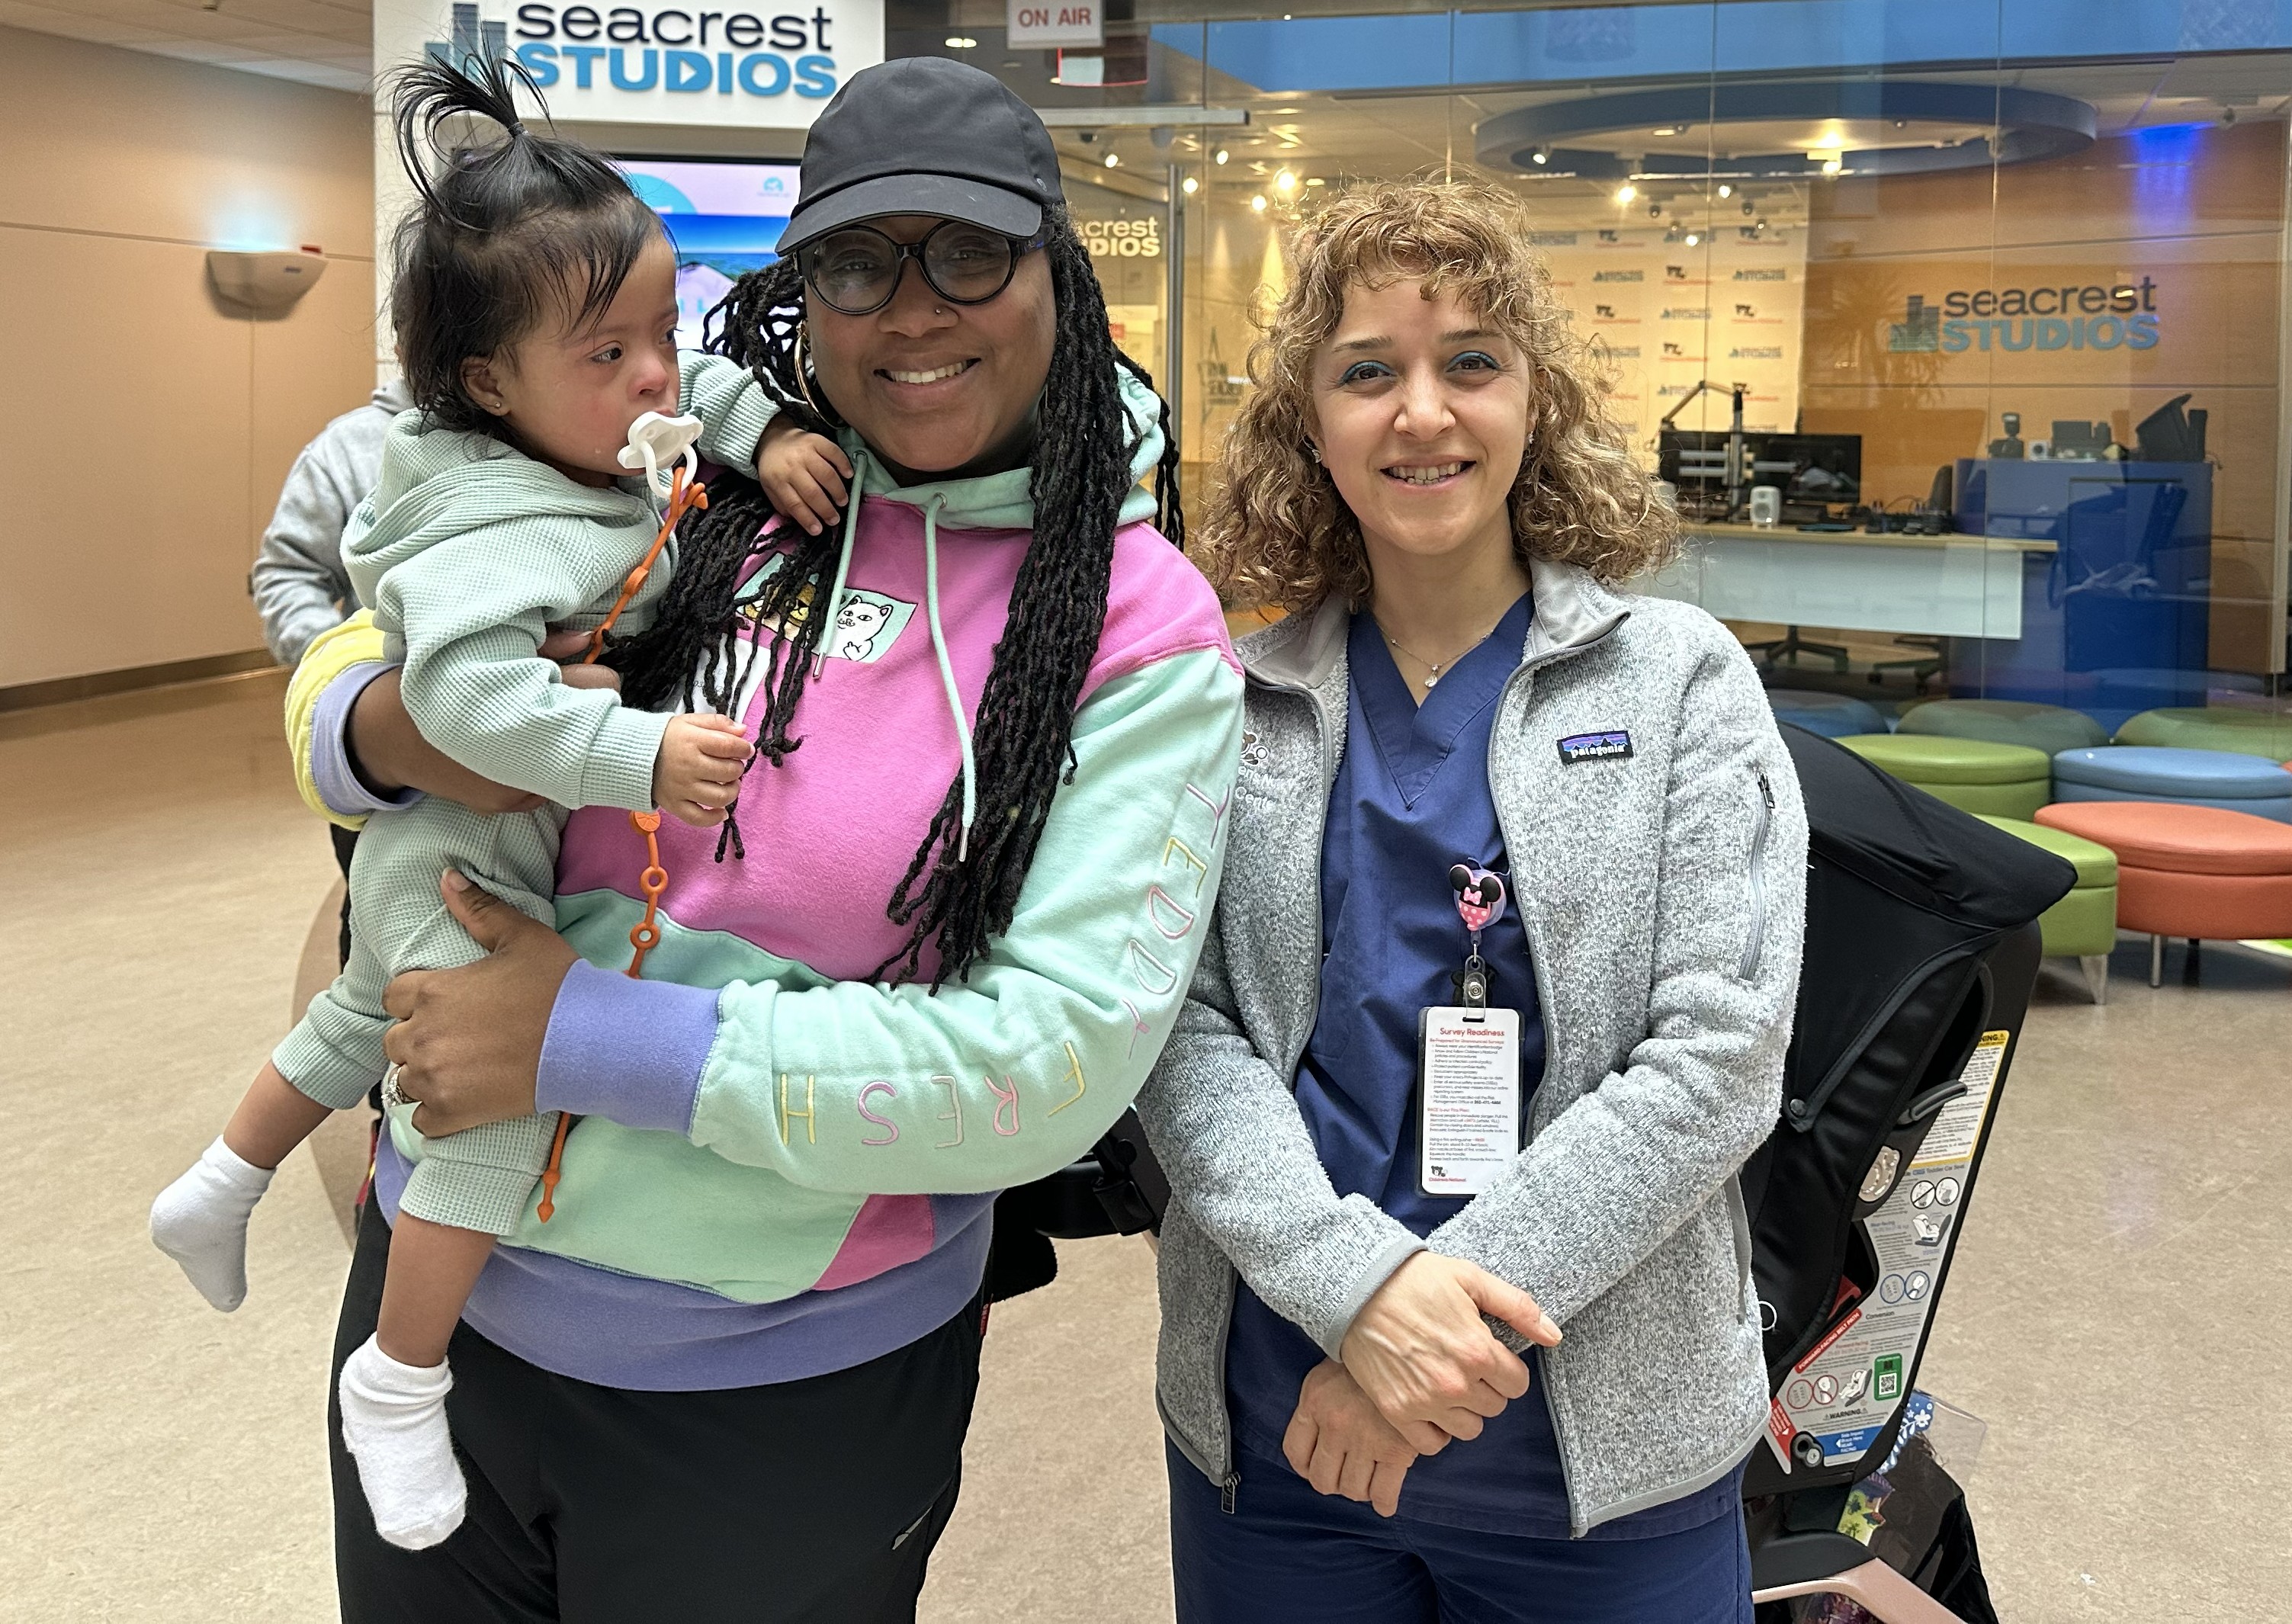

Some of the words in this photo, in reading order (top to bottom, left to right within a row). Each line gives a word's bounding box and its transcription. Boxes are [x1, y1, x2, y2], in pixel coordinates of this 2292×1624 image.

[515, 4, 832, 52] seacrest
[1018, 8, 1049, 27] ON
[1058, 6, 1092, 26] AIR
[516, 42, 837, 98] STUDIOS
[1943, 276, 2157, 317] seacrest
[1942, 313, 2159, 352] STUDIOS
[1121, 783, 1231, 1061] TEDDY
[1440, 1027, 1465, 1037] Survey
[1466, 1028, 1505, 1037] Readiness
[779, 1039, 1087, 1150] FRESH
[1865, 1311, 1896, 1320] Conversion
[1830, 1407, 1861, 1419] WARNING
